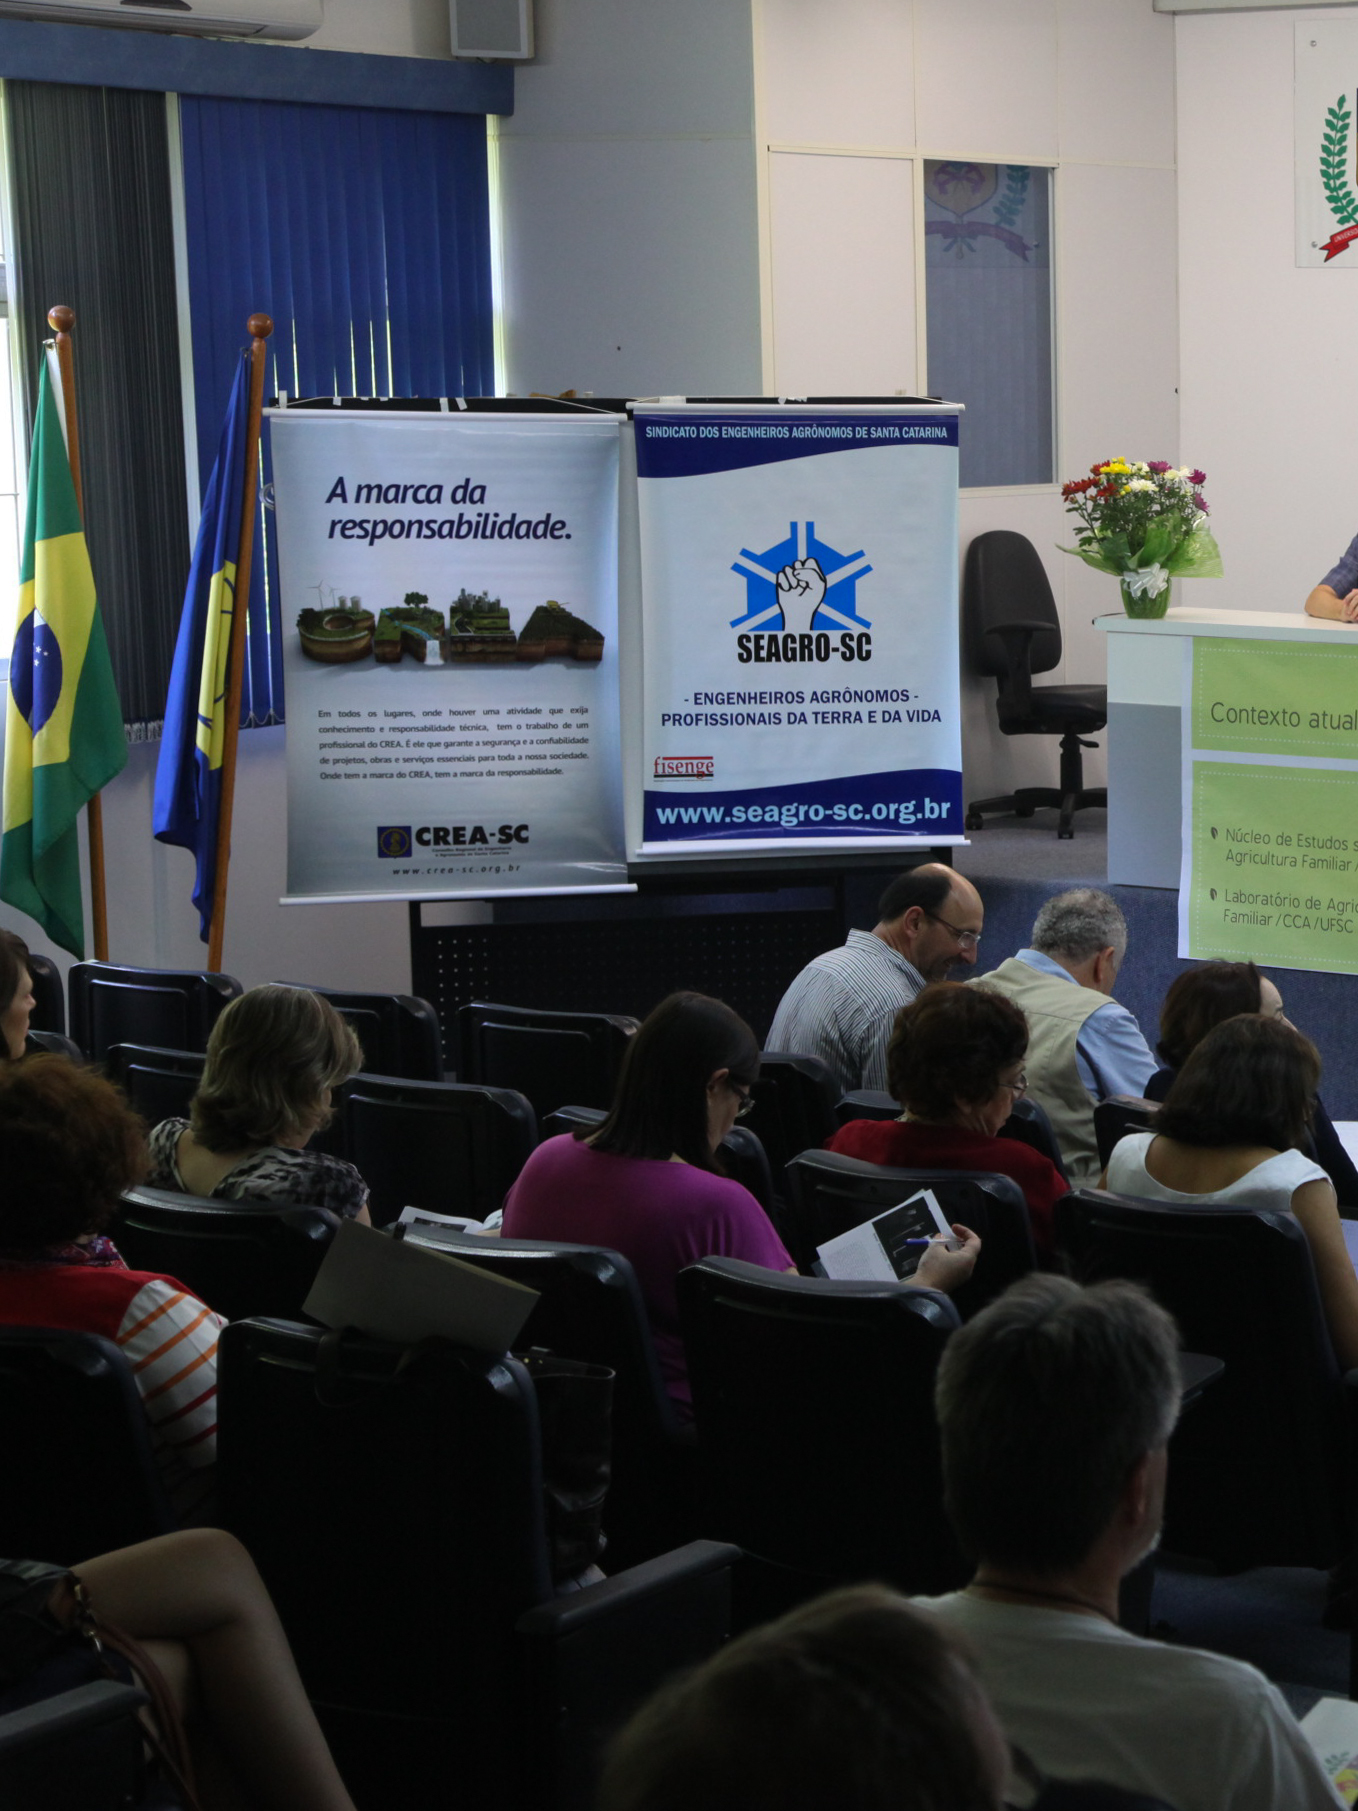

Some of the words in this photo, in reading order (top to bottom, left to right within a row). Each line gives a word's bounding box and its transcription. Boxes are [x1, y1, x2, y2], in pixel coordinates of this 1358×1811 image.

[646, 426, 696, 438] SINDICATO
[700, 426, 719, 438] DOS
[722, 426, 789, 438] ENGENHEIROS
[792, 424, 852, 438] AGRÔNOMOS
[856, 427, 868, 438] DE
[870, 427, 900, 438] SANTA
[902, 427, 947, 438] CATARINA
[325, 476, 348, 504] A
[354, 483, 443, 504] marca
[451, 478, 487, 505] da
[328, 513, 572, 546] responsabilidade.
[737, 631, 872, 663] SEAGRO-SC
[694, 691, 805, 705] ENGENHEIROS
[809, 687, 910, 704] AGRÔNOMOS
[318, 710, 331, 718] Em
[338, 710, 361, 718] todos
[384, 710, 415, 719] lugares,
[422, 709, 442, 717] onde
[507, 707, 542, 715] atividade
[549, 708, 563, 716] que
[570, 706, 588, 715] exija
[662, 712, 782, 726] PROFISSIONAIS
[787, 712, 808, 725] DA
[812, 711, 863, 724] TERRA
[868, 711, 877, 724] E
[882, 710, 902, 723] DA
[906, 709, 941, 723] VIDA
[1210, 702, 1301, 729] Contexto
[389, 725, 455, 734] responsabilidade
[460, 724, 489, 732] técnica,
[319, 741, 365, 750] profissional
[380, 740, 403, 748] CREA.
[406, 739, 411, 748] É
[413, 740, 424, 748] ele
[427, 741, 441, 749] que
[444, 740, 473, 749] garante
[482, 740, 520, 748] segurança
[536, 737, 589, 745] confiabilidade
[332, 757, 368, 766] projetos,
[402, 756, 434, 765] serviços
[437, 755, 475, 763] essenciais
[478, 755, 495, 763] para
[653, 756, 714, 779] fisenge
[409, 771, 433, 779] CREA,
[498, 768, 564, 777] responsabilidade.
[656, 797, 951, 827] www.seagro-sc.org.br
[415, 824, 529, 846] CREA-SC
[1226, 828, 1271, 844] Núcleo
[1276, 832, 1292, 846] de
[1297, 834, 1349, 851] Estudos
[1226, 849, 1297, 869] Agricultura
[1225, 889, 1300, 909] Laboratório
[1305, 895, 1321, 910] de
